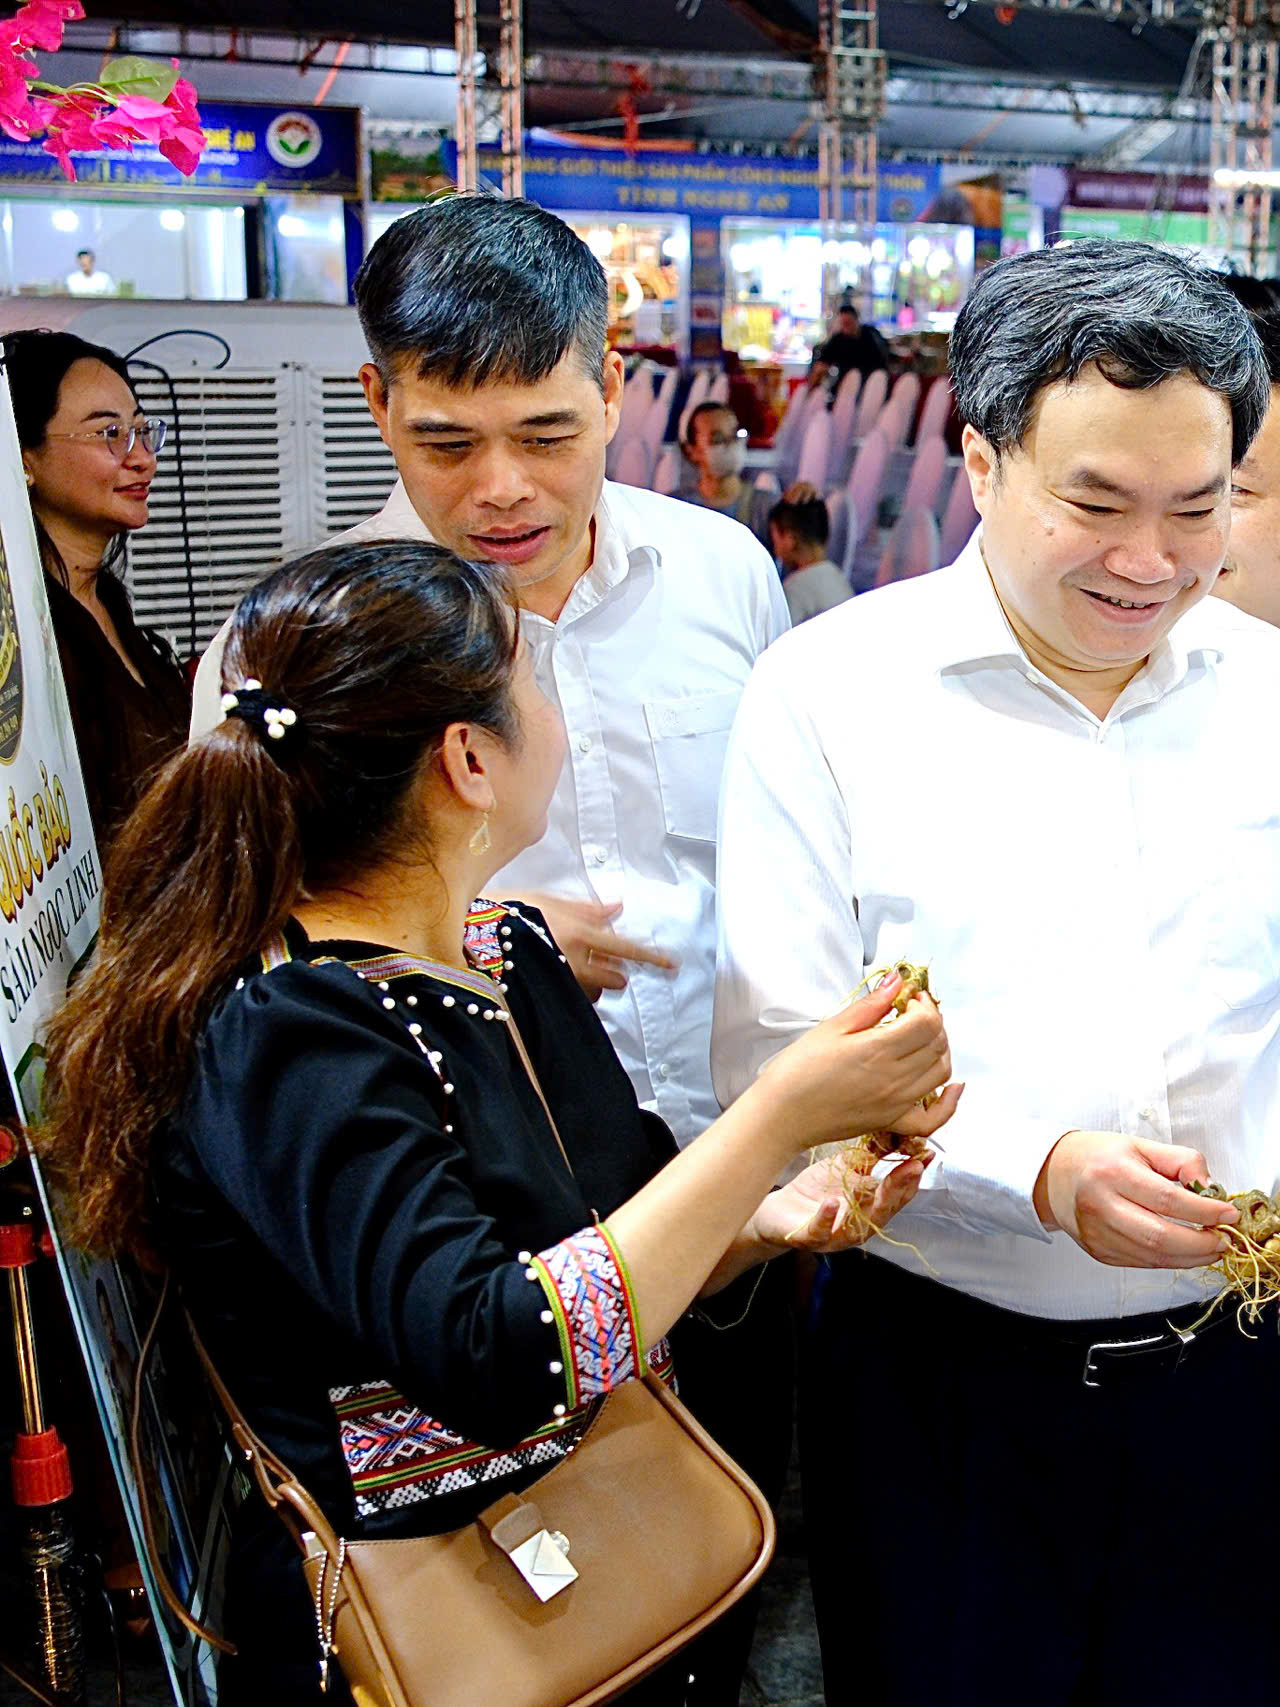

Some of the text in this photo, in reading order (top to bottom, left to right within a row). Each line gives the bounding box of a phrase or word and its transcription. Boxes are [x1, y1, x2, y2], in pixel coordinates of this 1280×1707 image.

[33, 759, 72, 872] BẢO
[0, 849, 99, 1024] SÂM NGỌC LINH
